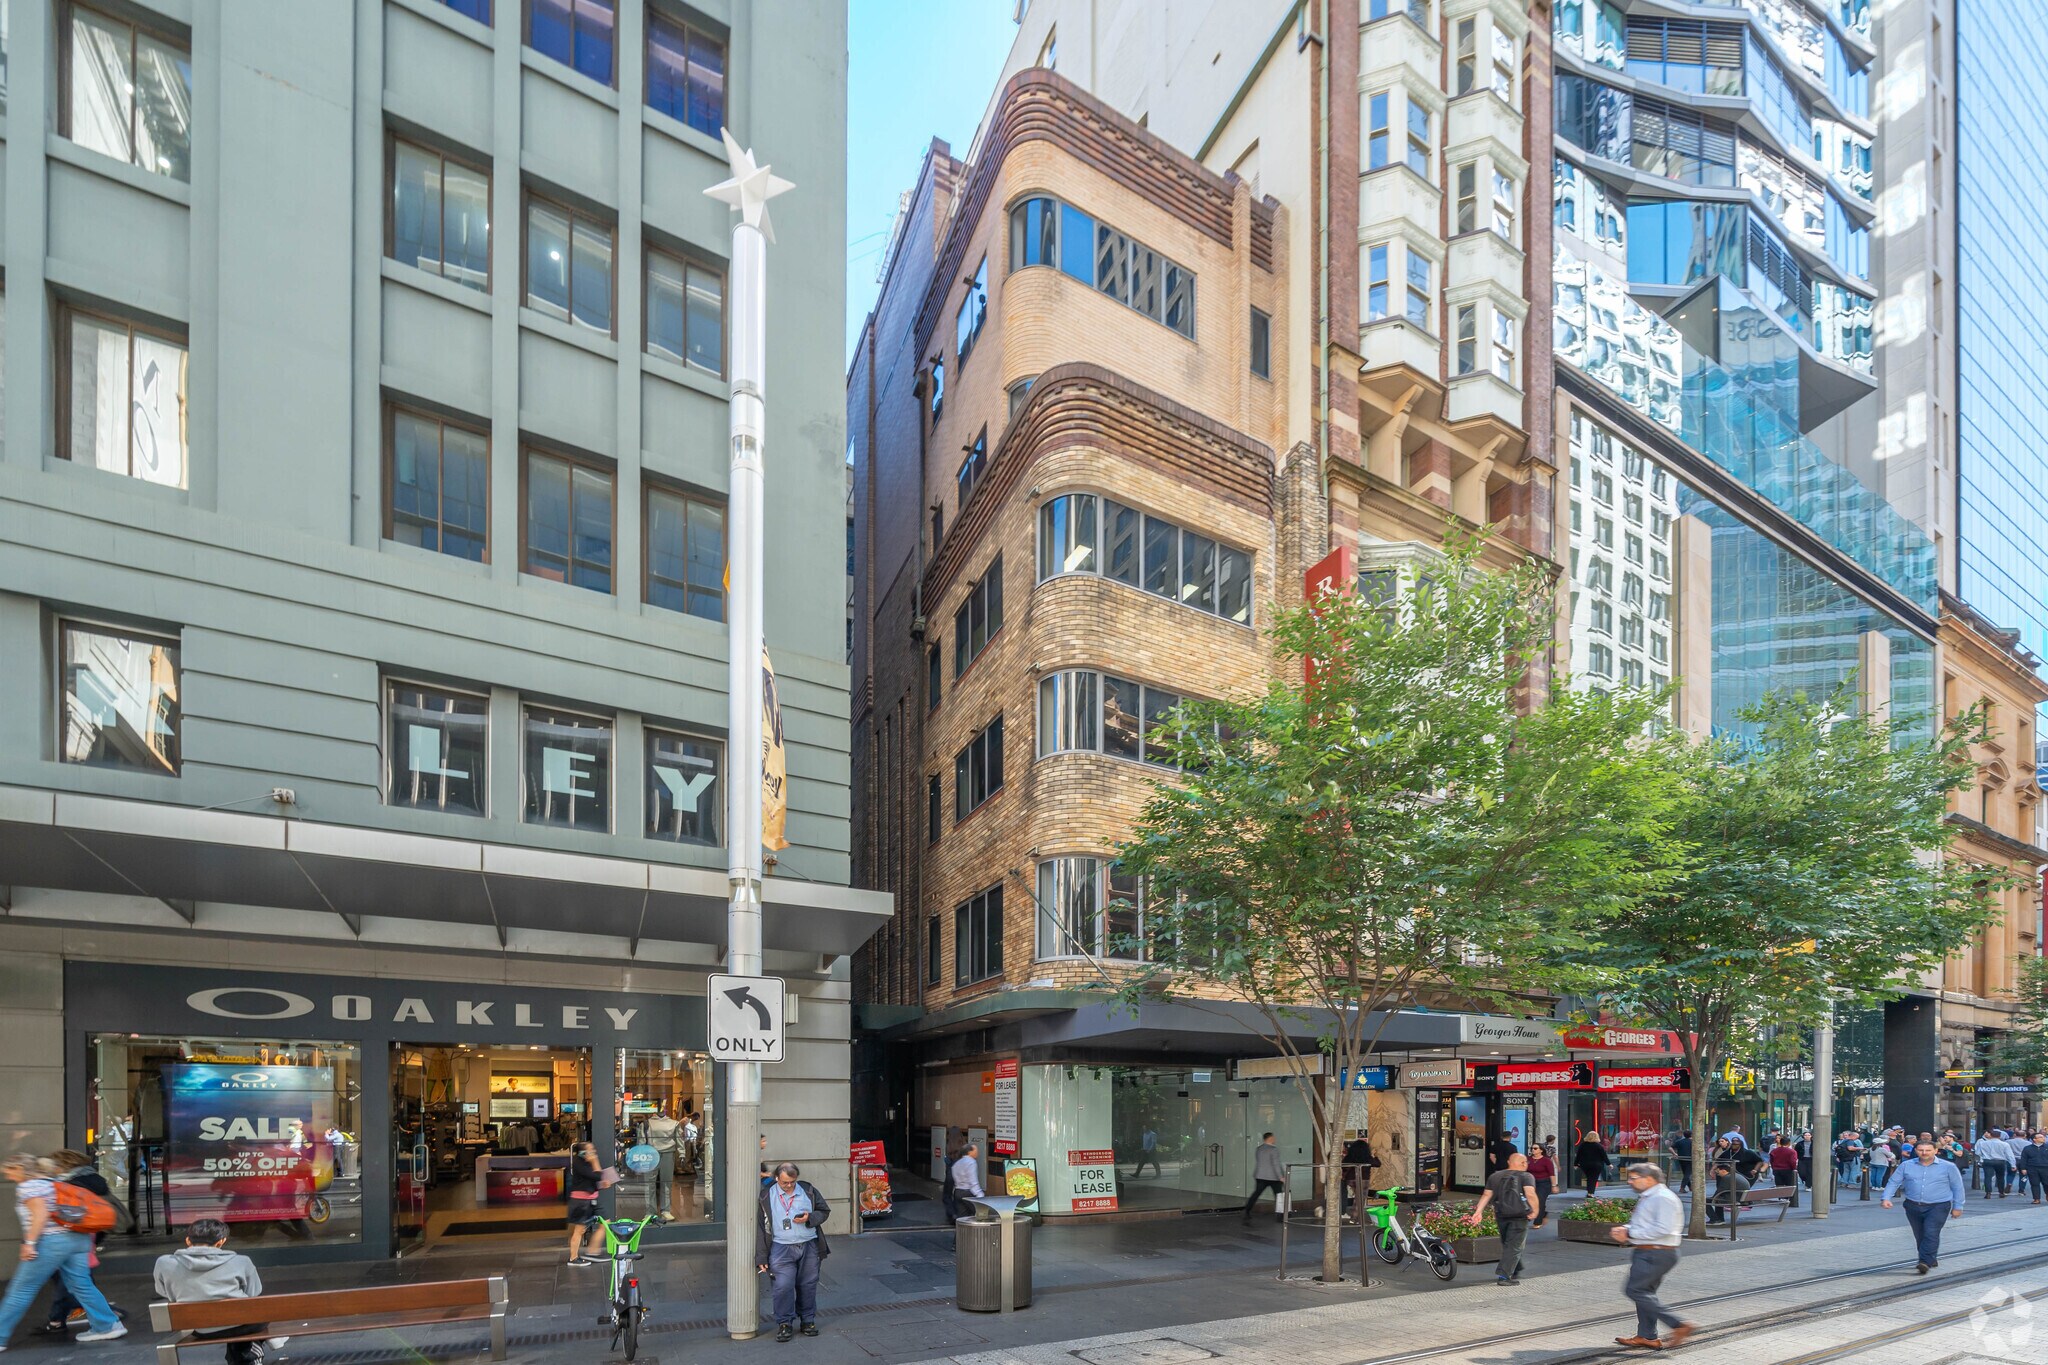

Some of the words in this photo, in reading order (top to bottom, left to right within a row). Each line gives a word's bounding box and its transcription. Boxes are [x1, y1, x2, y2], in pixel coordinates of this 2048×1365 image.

[332, 995, 639, 1031] OAKLEY
[1474, 1022, 1511, 1040] Georges
[1512, 1025, 1540, 1038] House
[1604, 1029, 1656, 1046] GEORGES
[716, 1037, 776, 1052] ONLY
[1004, 1081, 1016, 1089] LEASE
[1497, 1071, 1571, 1086] GEORGES
[1598, 1075, 1672, 1089] GEORGES
[1420, 1111, 1430, 1119] EOS
[198, 1116, 301, 1141] SALE
[203, 1157, 252, 1171] 50%
[510, 1176, 541, 1186] SALE
[1080, 1169, 1105, 1180] FOR
[1074, 1182, 1113, 1194] LEASE
[1078, 1200, 1095, 1208] 8217
[1095, 1199, 1111, 1207] 8888
